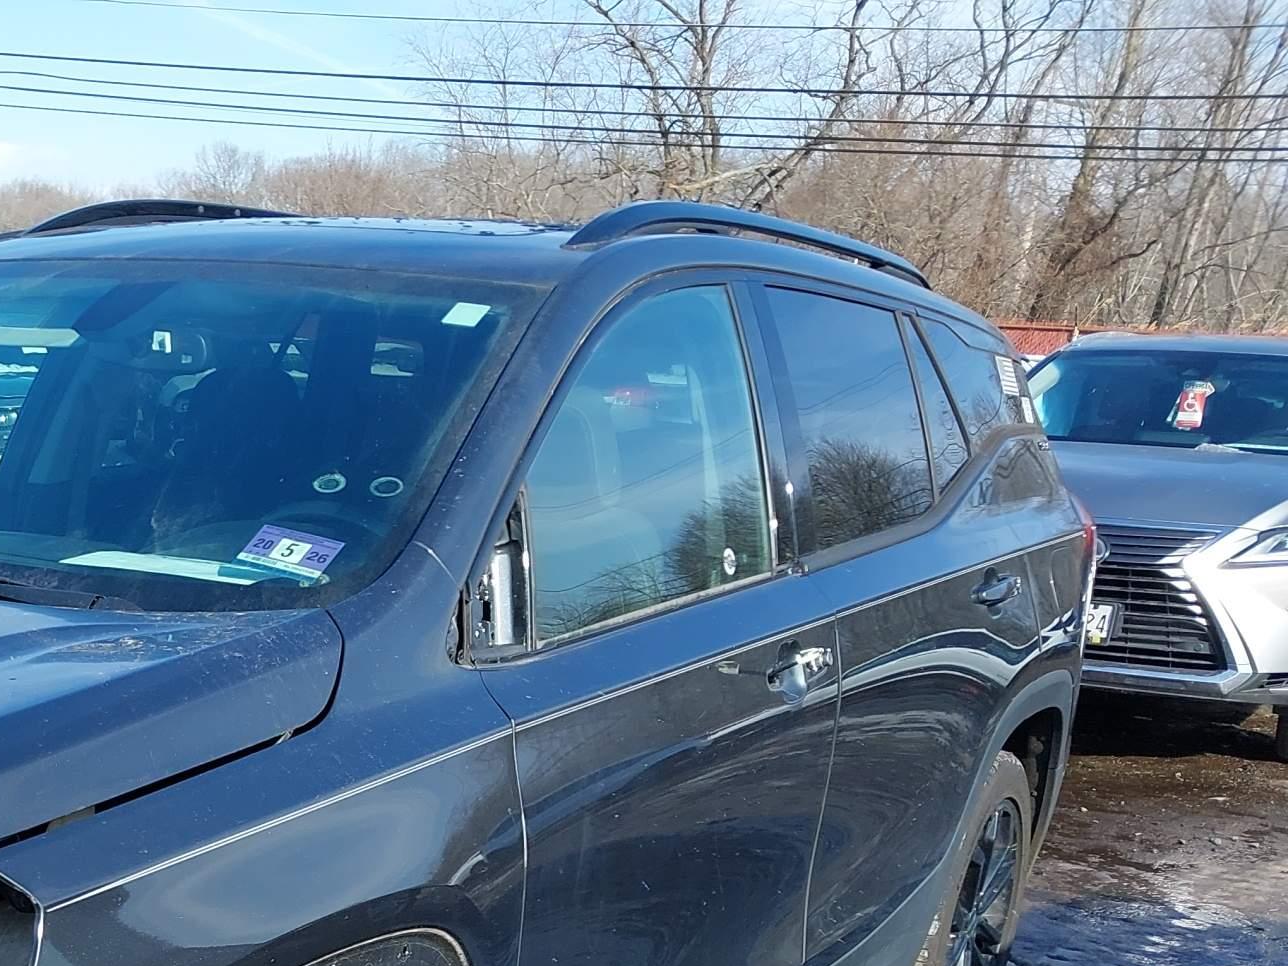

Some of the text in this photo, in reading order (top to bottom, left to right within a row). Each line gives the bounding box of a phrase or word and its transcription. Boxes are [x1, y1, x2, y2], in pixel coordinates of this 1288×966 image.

[253, 537, 329, 564] 20 5 26
